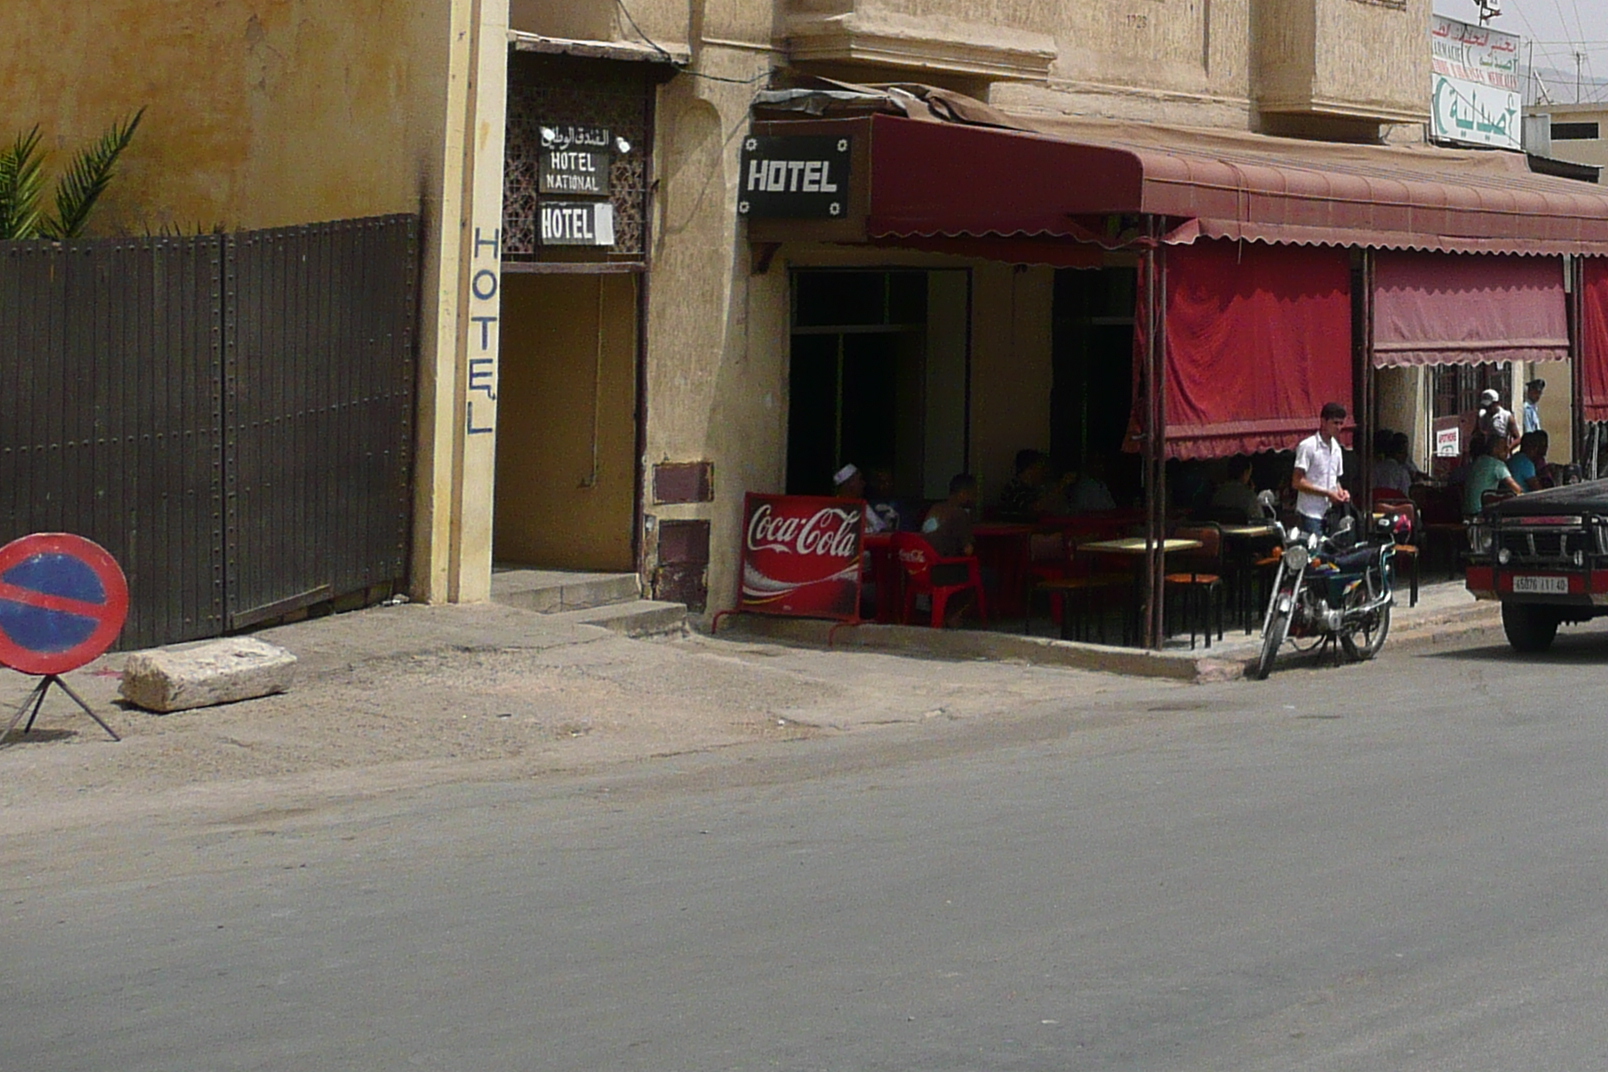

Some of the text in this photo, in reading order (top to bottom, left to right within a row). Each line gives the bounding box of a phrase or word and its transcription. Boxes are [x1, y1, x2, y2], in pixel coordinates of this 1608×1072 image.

[551, 151, 596, 172] HOTEL
[747, 159, 838, 193] HOTEL
[546, 174, 599, 191] NATIONAL
[542, 207, 593, 239] HOTEL
[467, 226, 500, 435] HOTEL
[747, 504, 862, 557] Coca-Cola
